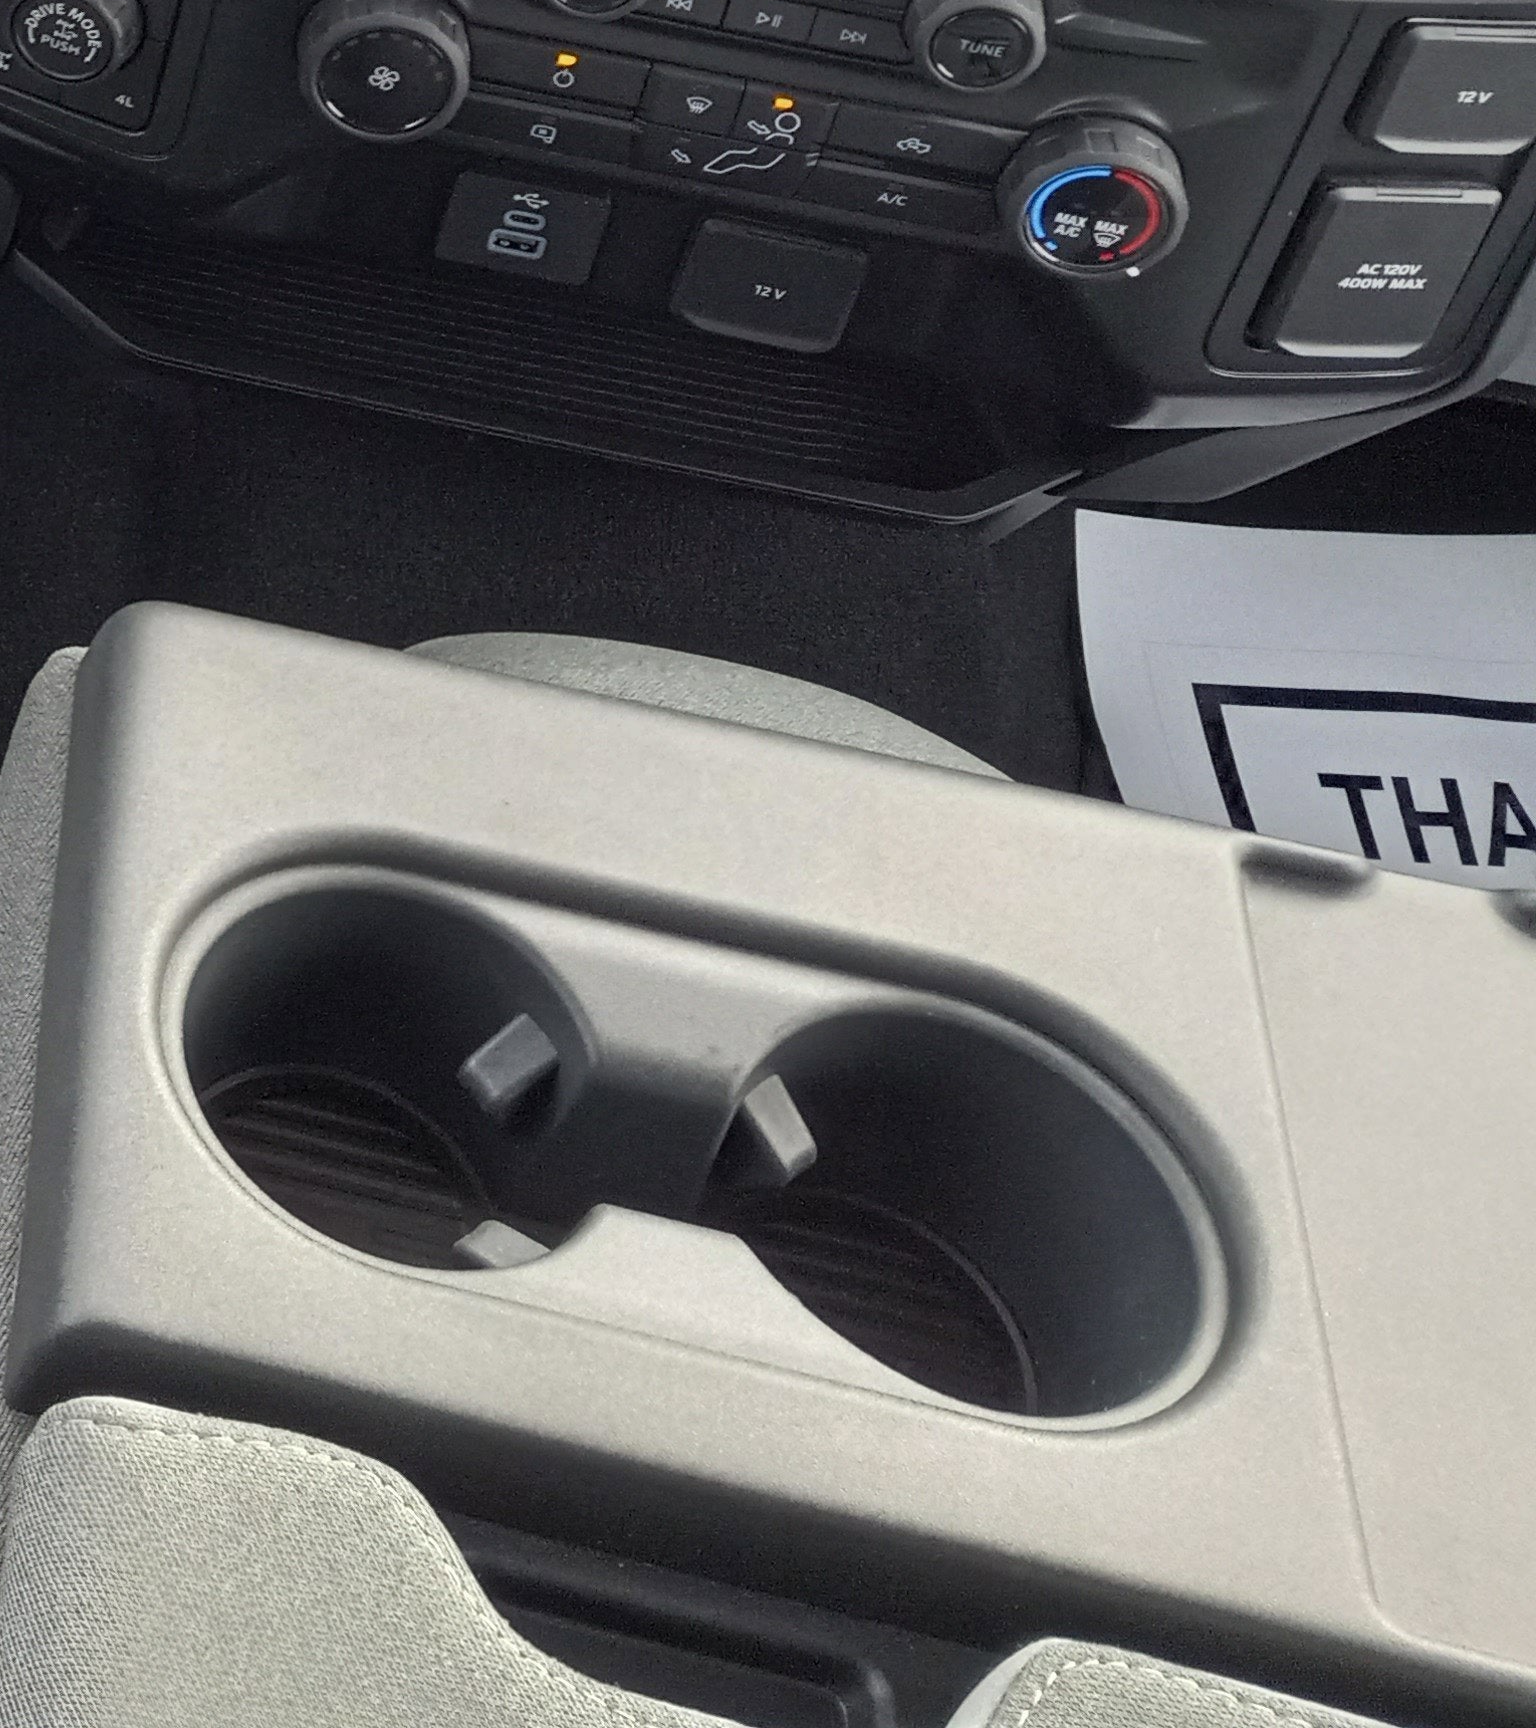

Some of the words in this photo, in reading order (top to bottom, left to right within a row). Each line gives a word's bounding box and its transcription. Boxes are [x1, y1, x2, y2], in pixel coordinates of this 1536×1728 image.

[24, 2, 66, 29] DRIVE
[67, 7, 103, 49] MODE
[40, 33, 82, 56] PUSH
[959, 38, 1008, 60] TUNE
[114, 94, 135, 108] 4L
[877, 191, 909, 208] A/C
[1054, 211, 1089, 229] MAX
[1094, 219, 1129, 236] MAX
[1356, 263, 1383, 276] AC
[1383, 264, 1424, 276] 120V
[1337, 277, 1389, 290] 400W
[1388, 278, 1428, 290] MAX
